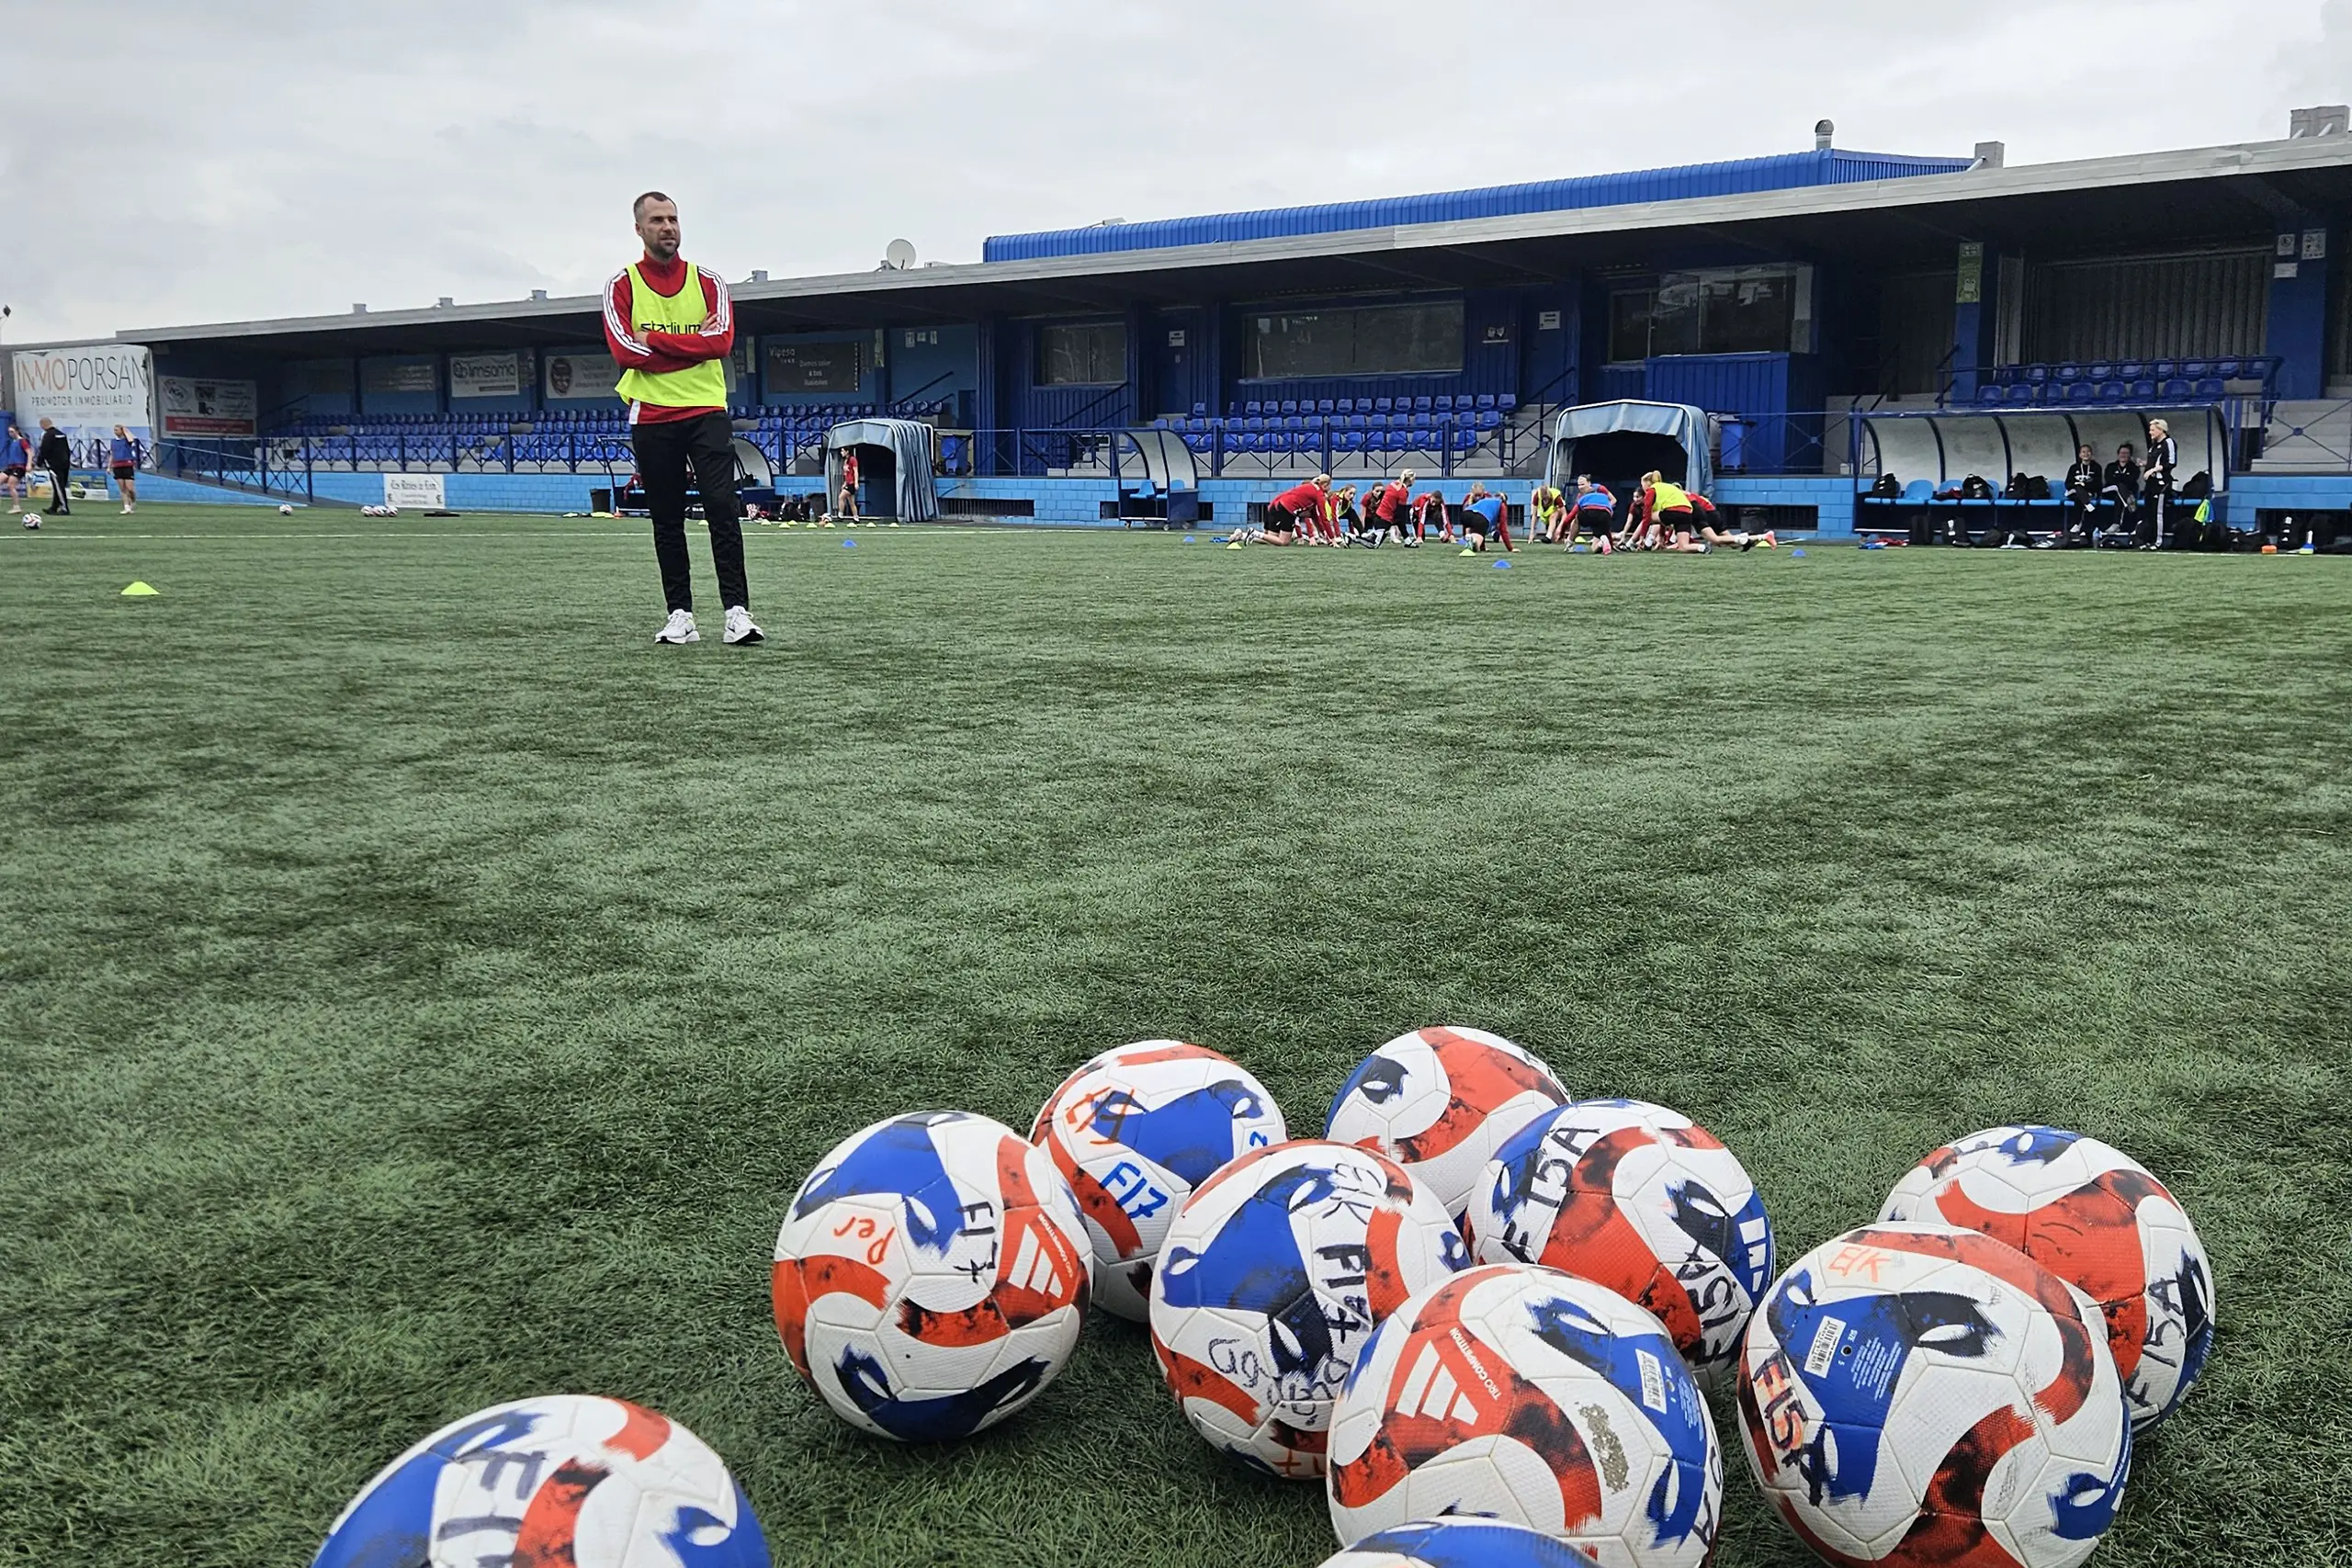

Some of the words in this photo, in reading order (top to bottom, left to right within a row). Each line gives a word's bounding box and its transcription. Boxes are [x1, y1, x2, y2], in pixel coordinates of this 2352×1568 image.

[31, 396, 73, 407] PROMOTOR
[75, 394, 132, 406] INMOBILIARIO
[1100, 1161, 1169, 1219] F17
[1449, 1327, 1488, 1381] COMPETITION
[1484, 1379, 1503, 1402] TIRO
